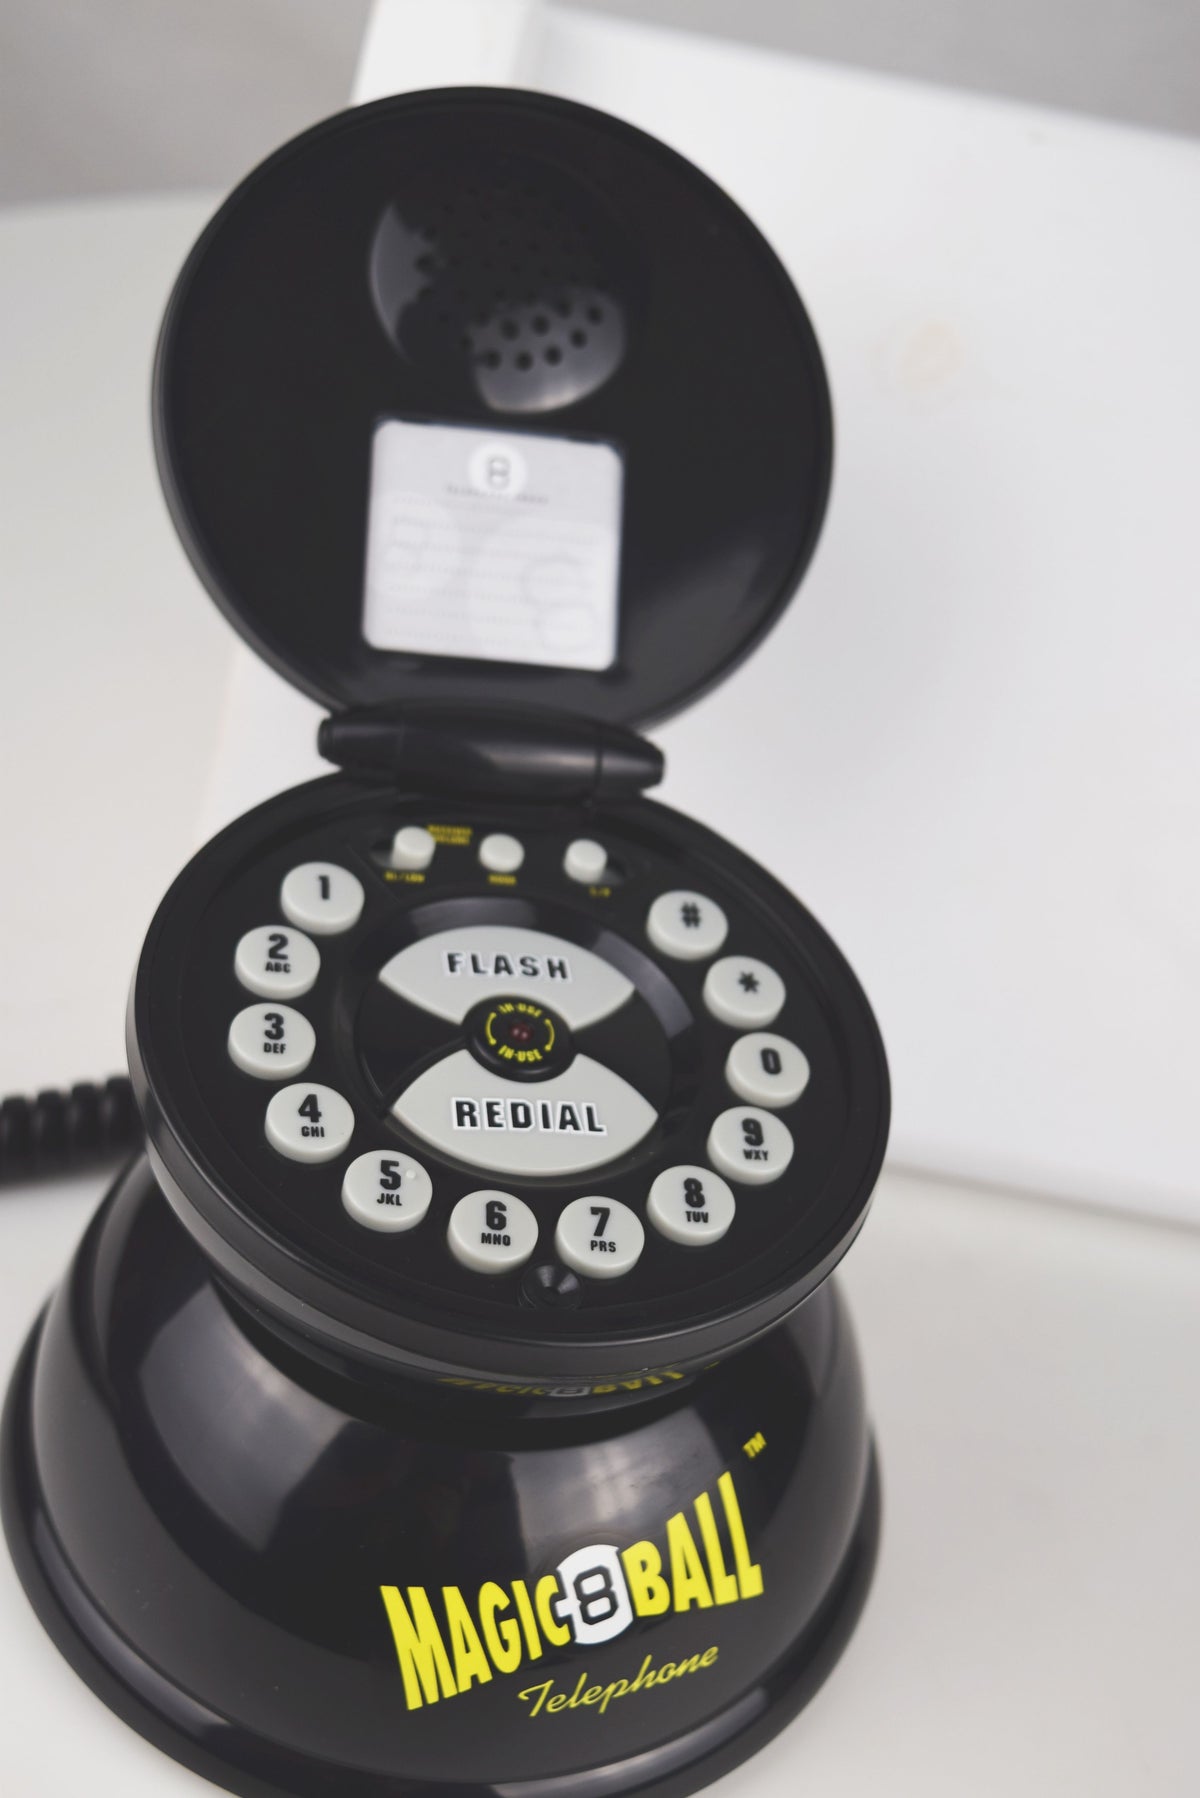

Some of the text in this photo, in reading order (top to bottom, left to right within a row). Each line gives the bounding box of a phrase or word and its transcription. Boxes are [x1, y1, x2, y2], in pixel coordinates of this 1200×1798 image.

[319, 874, 330, 900] 1
[681, 903, 701, 928] #
[267, 933, 288, 960] 2
[265, 962, 291, 973] ABC
[446, 953, 569, 980] FLASH
[263, 1012, 285, 1040] 3
[263, 1042, 286, 1054] DEF
[298, 1093, 322, 1123] 4
[454, 1099, 605, 1134] REDIAL
[301, 1126, 325, 1138] GHI
[741, 1117, 765, 1147] 9
[743, 1149, 769, 1162] WXY
[380, 1159, 402, 1191] 5
[376, 1193, 403, 1207] JKL
[684, 1177, 706, 1208] 8
[485, 1200, 507, 1231] 6
[590, 1206, 611, 1237] 7
[685, 1210, 709, 1224] TUV
[481, 1232, 511, 1246] MNO
[590, 1239, 617, 1252] PRS
[743, 1432, 767, 1459] TM
[380, 1575, 571, 1711] MAGIC
[621, 1471, 764, 1617] BALL
[518, 1646, 719, 1717] Telephone
